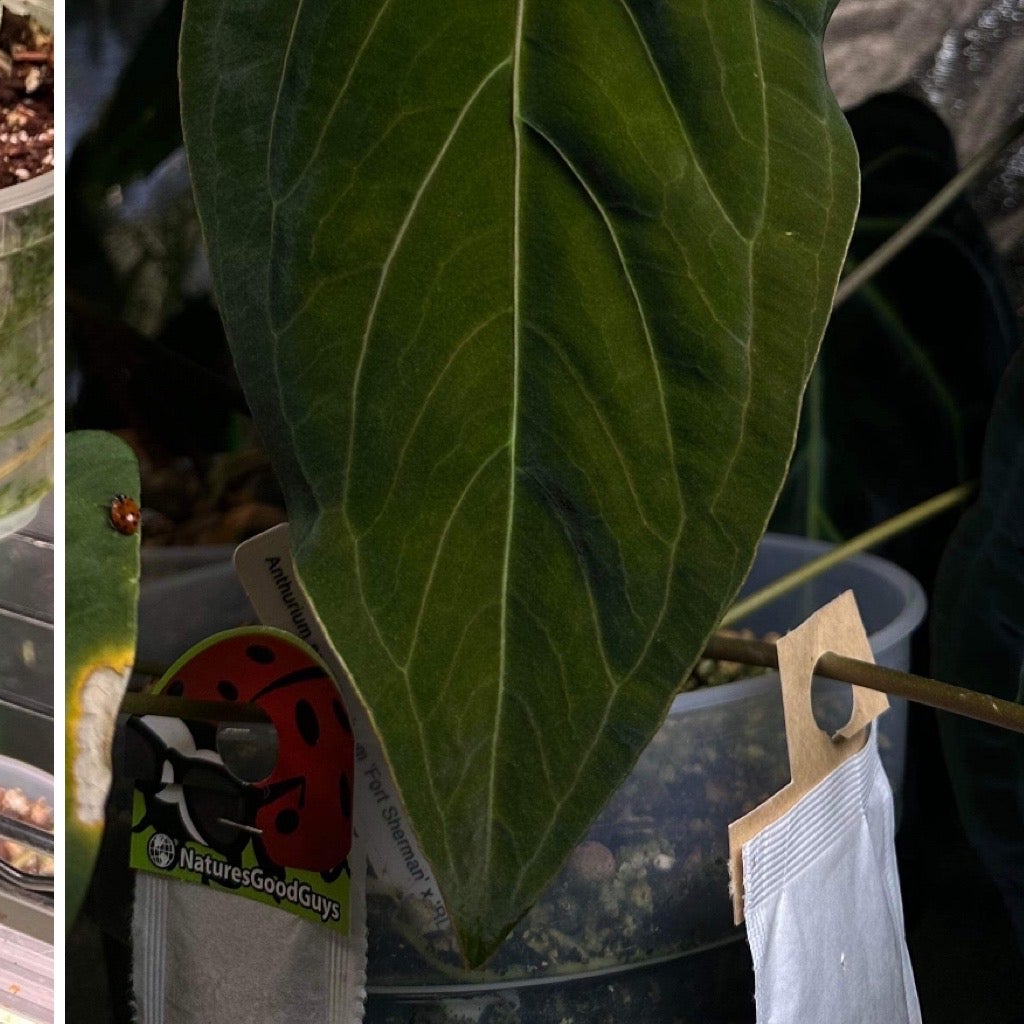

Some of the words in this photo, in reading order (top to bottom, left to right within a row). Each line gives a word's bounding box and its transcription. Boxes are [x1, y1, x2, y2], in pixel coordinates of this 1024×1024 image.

[265, 556, 312, 640] Anthurium
[364, 763, 390, 804] 'Fort
[382, 806, 430, 882] Sherman'
[421, 887, 434, 900] x
[179, 847, 342, 920] NaturesGoodGuys
